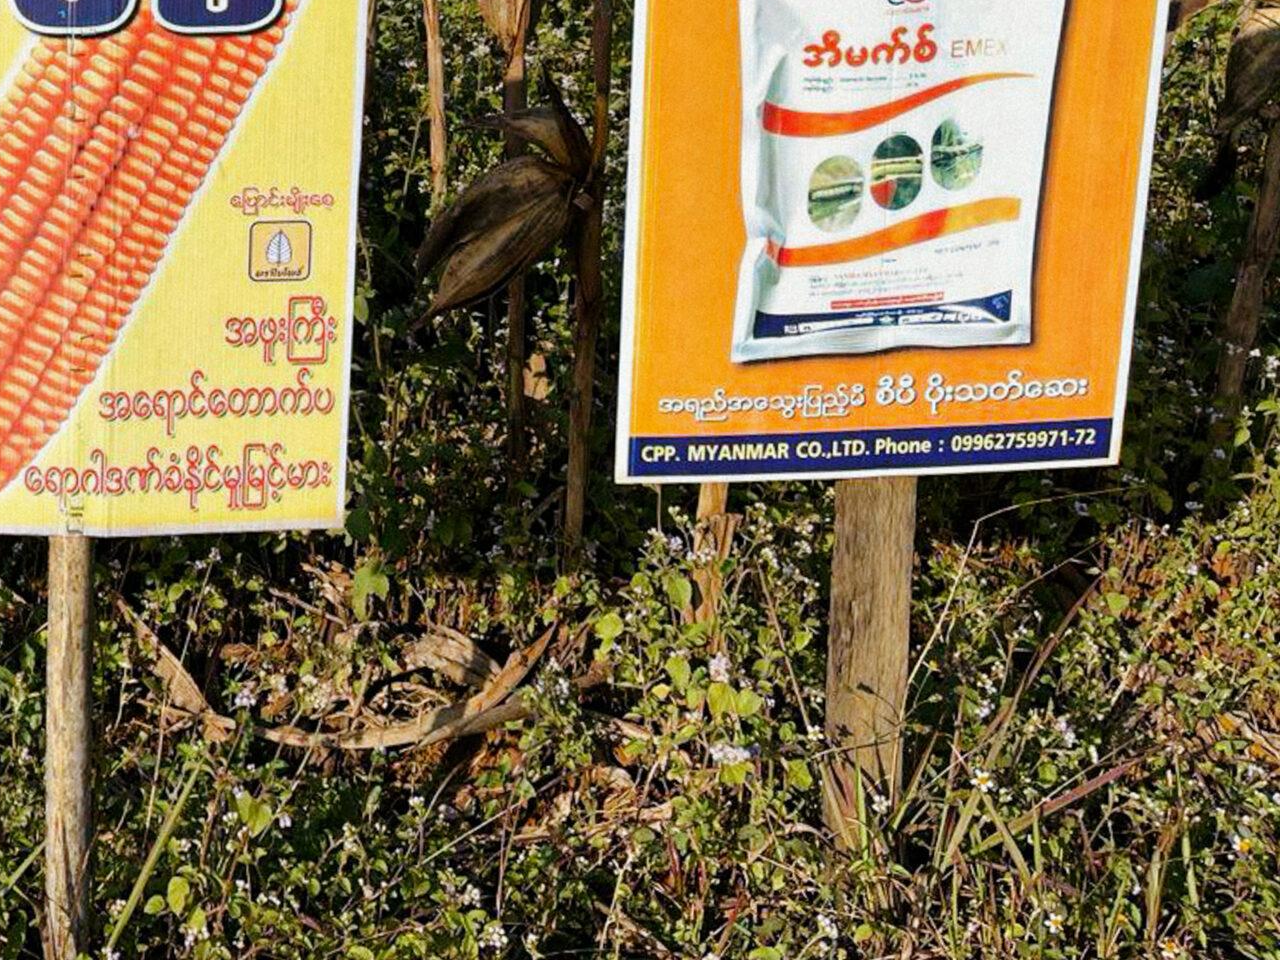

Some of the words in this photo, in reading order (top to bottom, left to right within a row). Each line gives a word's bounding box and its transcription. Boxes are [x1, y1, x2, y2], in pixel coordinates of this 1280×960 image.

[641, 445, 681, 463] CPP.
[687, 442, 790, 462] MYANMAR
[796, 439, 870, 460] CO.,LTD.
[875, 436, 932, 455] Phone
[951, 428, 1097, 453] 09962759971-72
